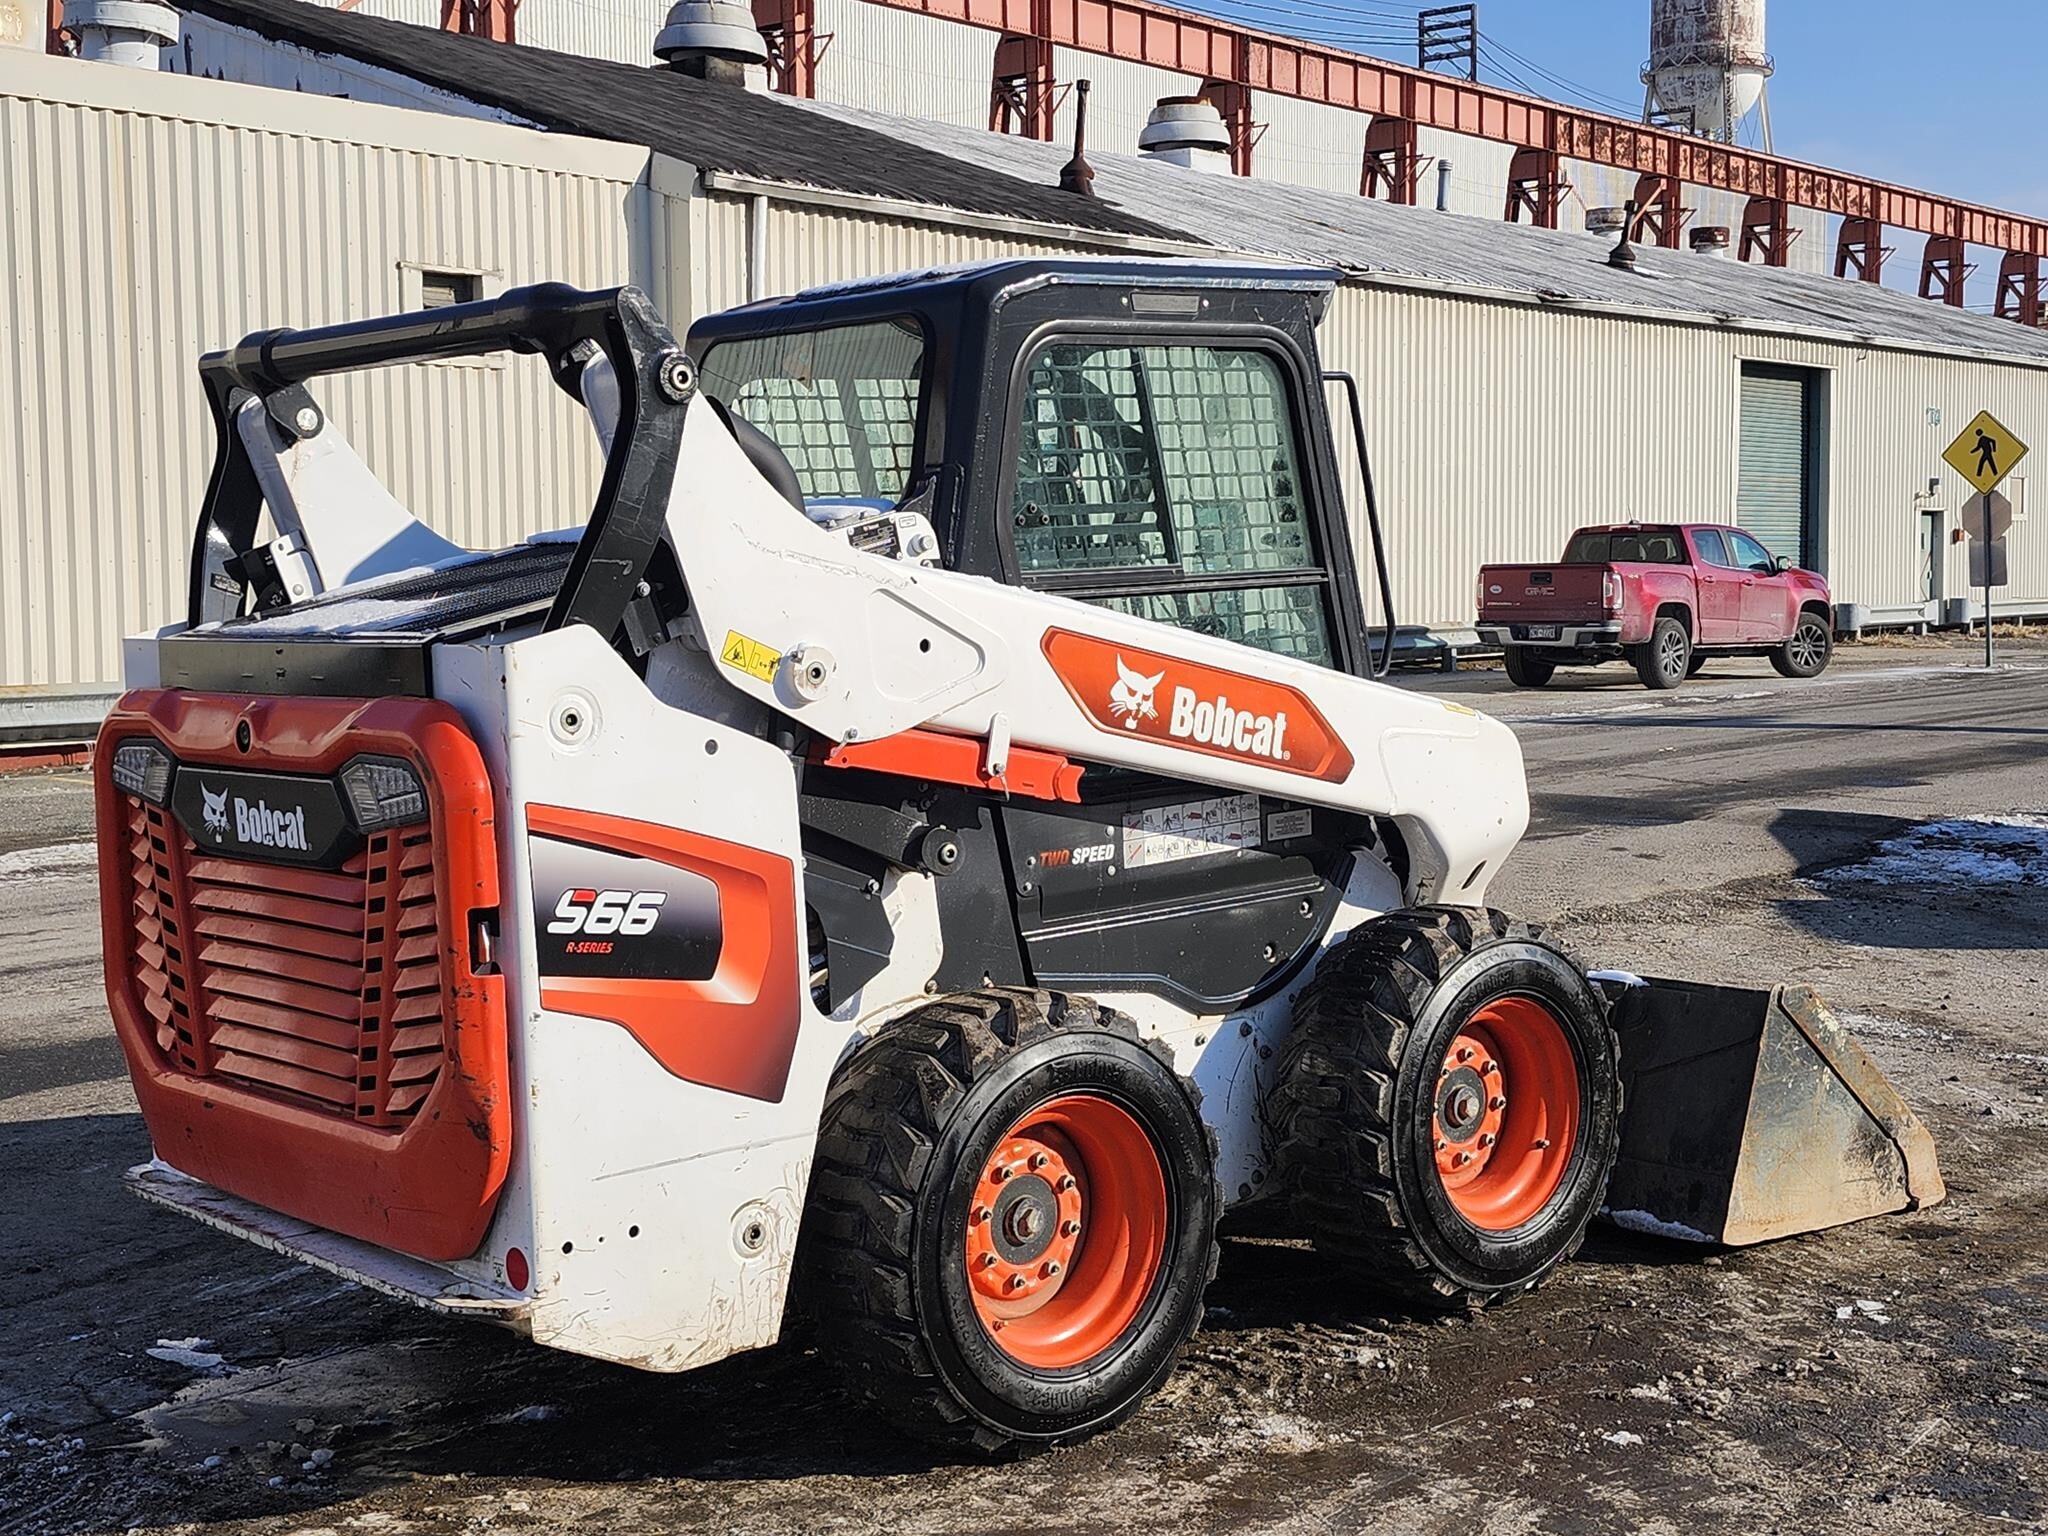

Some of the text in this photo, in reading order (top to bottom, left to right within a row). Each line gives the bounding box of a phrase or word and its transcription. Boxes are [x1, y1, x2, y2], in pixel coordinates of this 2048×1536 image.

[1169, 685, 1292, 760] Bobcat
[234, 797, 309, 851] Bobcat
[1040, 843, 1115, 867] TWO SPEED
[547, 888, 668, 936] S66
[565, 942, 614, 954] R-SERIES
